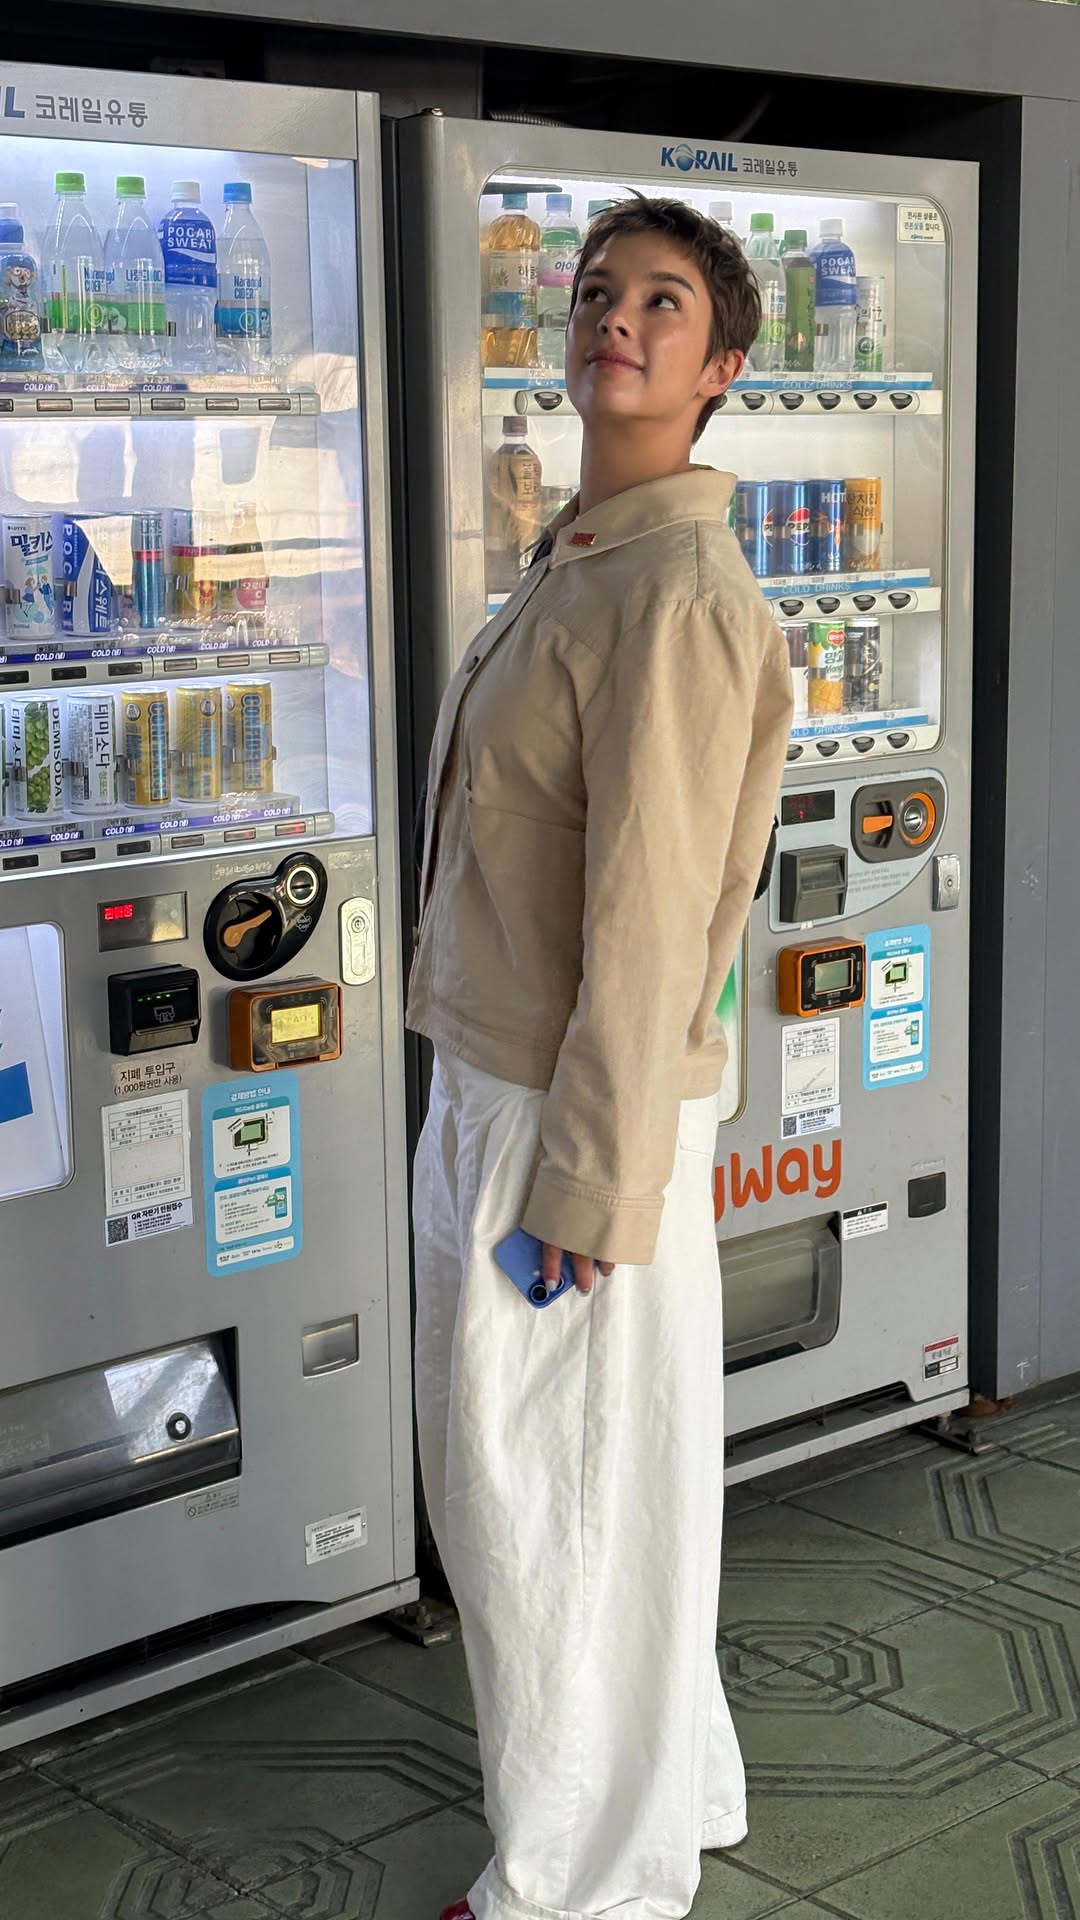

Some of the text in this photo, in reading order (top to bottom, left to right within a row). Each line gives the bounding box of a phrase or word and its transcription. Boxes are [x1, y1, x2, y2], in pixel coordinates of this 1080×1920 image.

[0, 86, 25, 118] L
[35, 94, 148, 128] 코레일유통
[660, 144, 738, 172] KORAIL
[742, 157, 798, 177] 코레일유통
[168, 226, 214, 240] POCARI
[168, 237, 212, 249] SWEAT
[24, 383, 42, 392] COLD
[142, 384, 162, 392] COLD
[782, 381, 853, 390] COLD DRINKS
[782, 582, 852, 595] COLD DRINKS
[91, 649, 111, 658] COLD
[147, 646, 166, 654] COLD
[34, 653, 55, 661] COLD
[94, 703, 111, 769] 데미소다
[789, 728, 810, 738] OLD
[52, 707, 63, 797] DEMISODA
[264, 809, 281, 817] COLD
[212, 815, 230, 823] COLD
[160, 821, 179, 829] COLD
[105, 827, 125, 836] COLD
[50, 832, 70, 842] COLD
[0, 838, 12, 847] OLD
[120, 1061, 176, 1082] 지폐 투입구
[113, 1074, 182, 1096] (1,000원권만 사용)
[131, 1212, 142, 1220] QR
